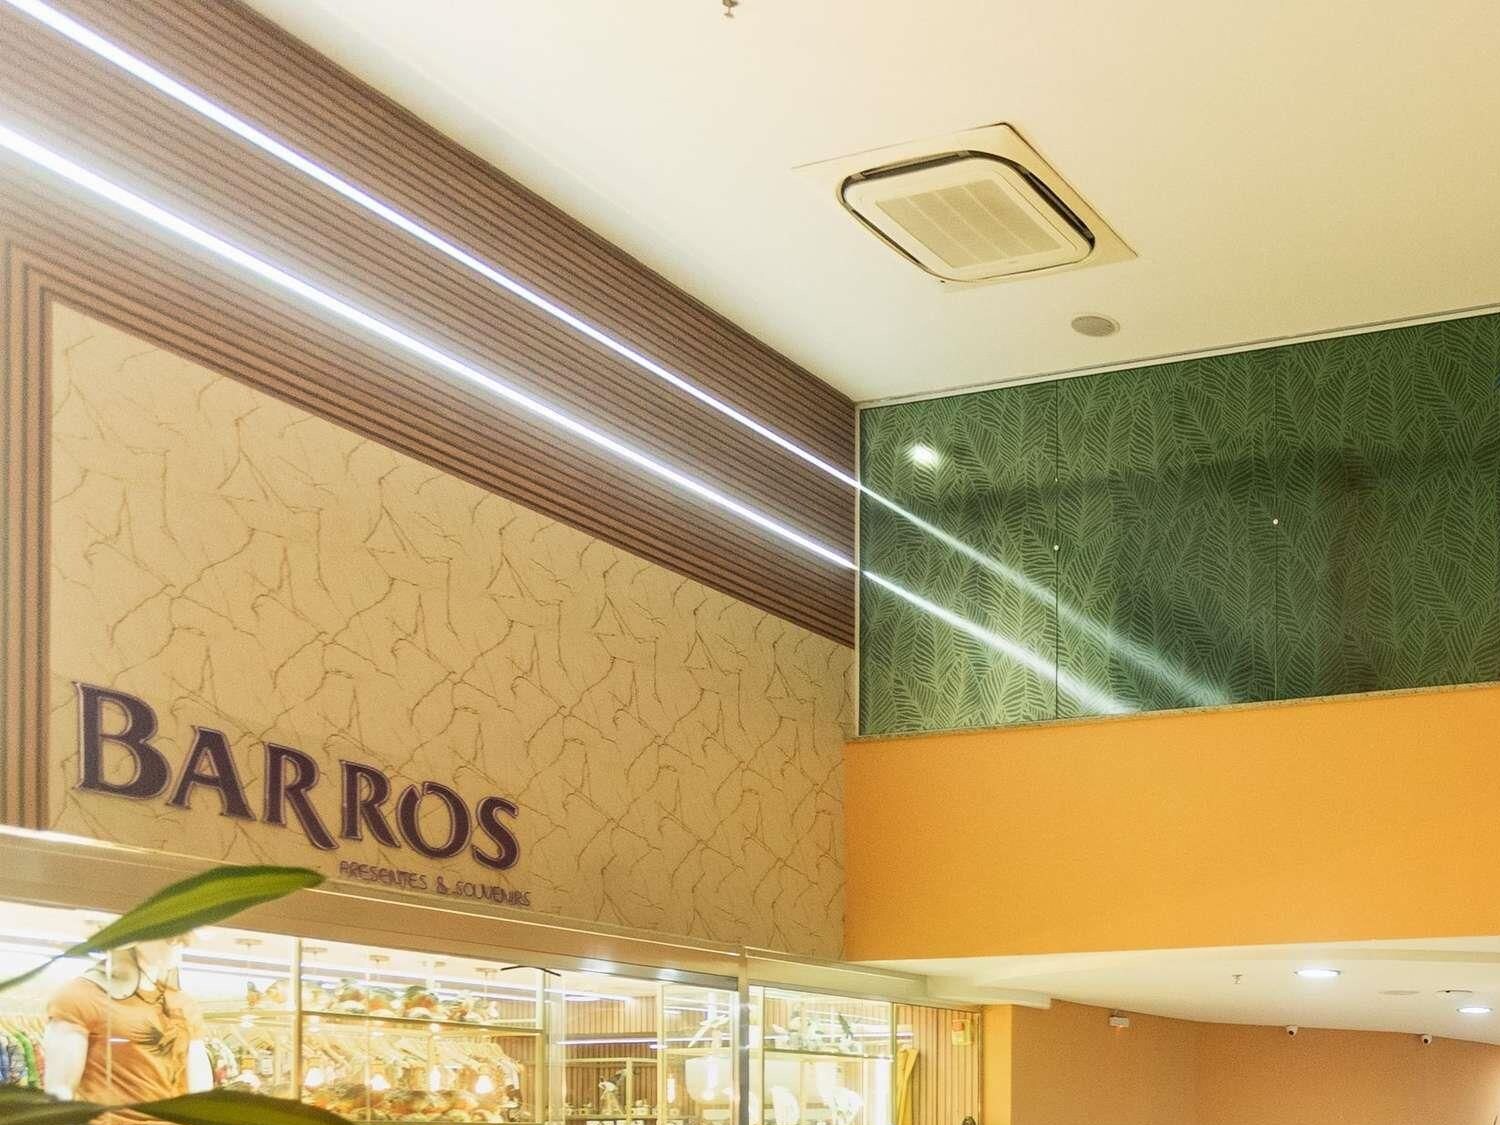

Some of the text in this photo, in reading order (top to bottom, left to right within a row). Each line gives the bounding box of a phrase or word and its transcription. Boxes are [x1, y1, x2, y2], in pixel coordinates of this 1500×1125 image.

[71, 681, 520, 871] BARROS
[339, 860, 531, 907] PRESENTES & SOUVENIRS
